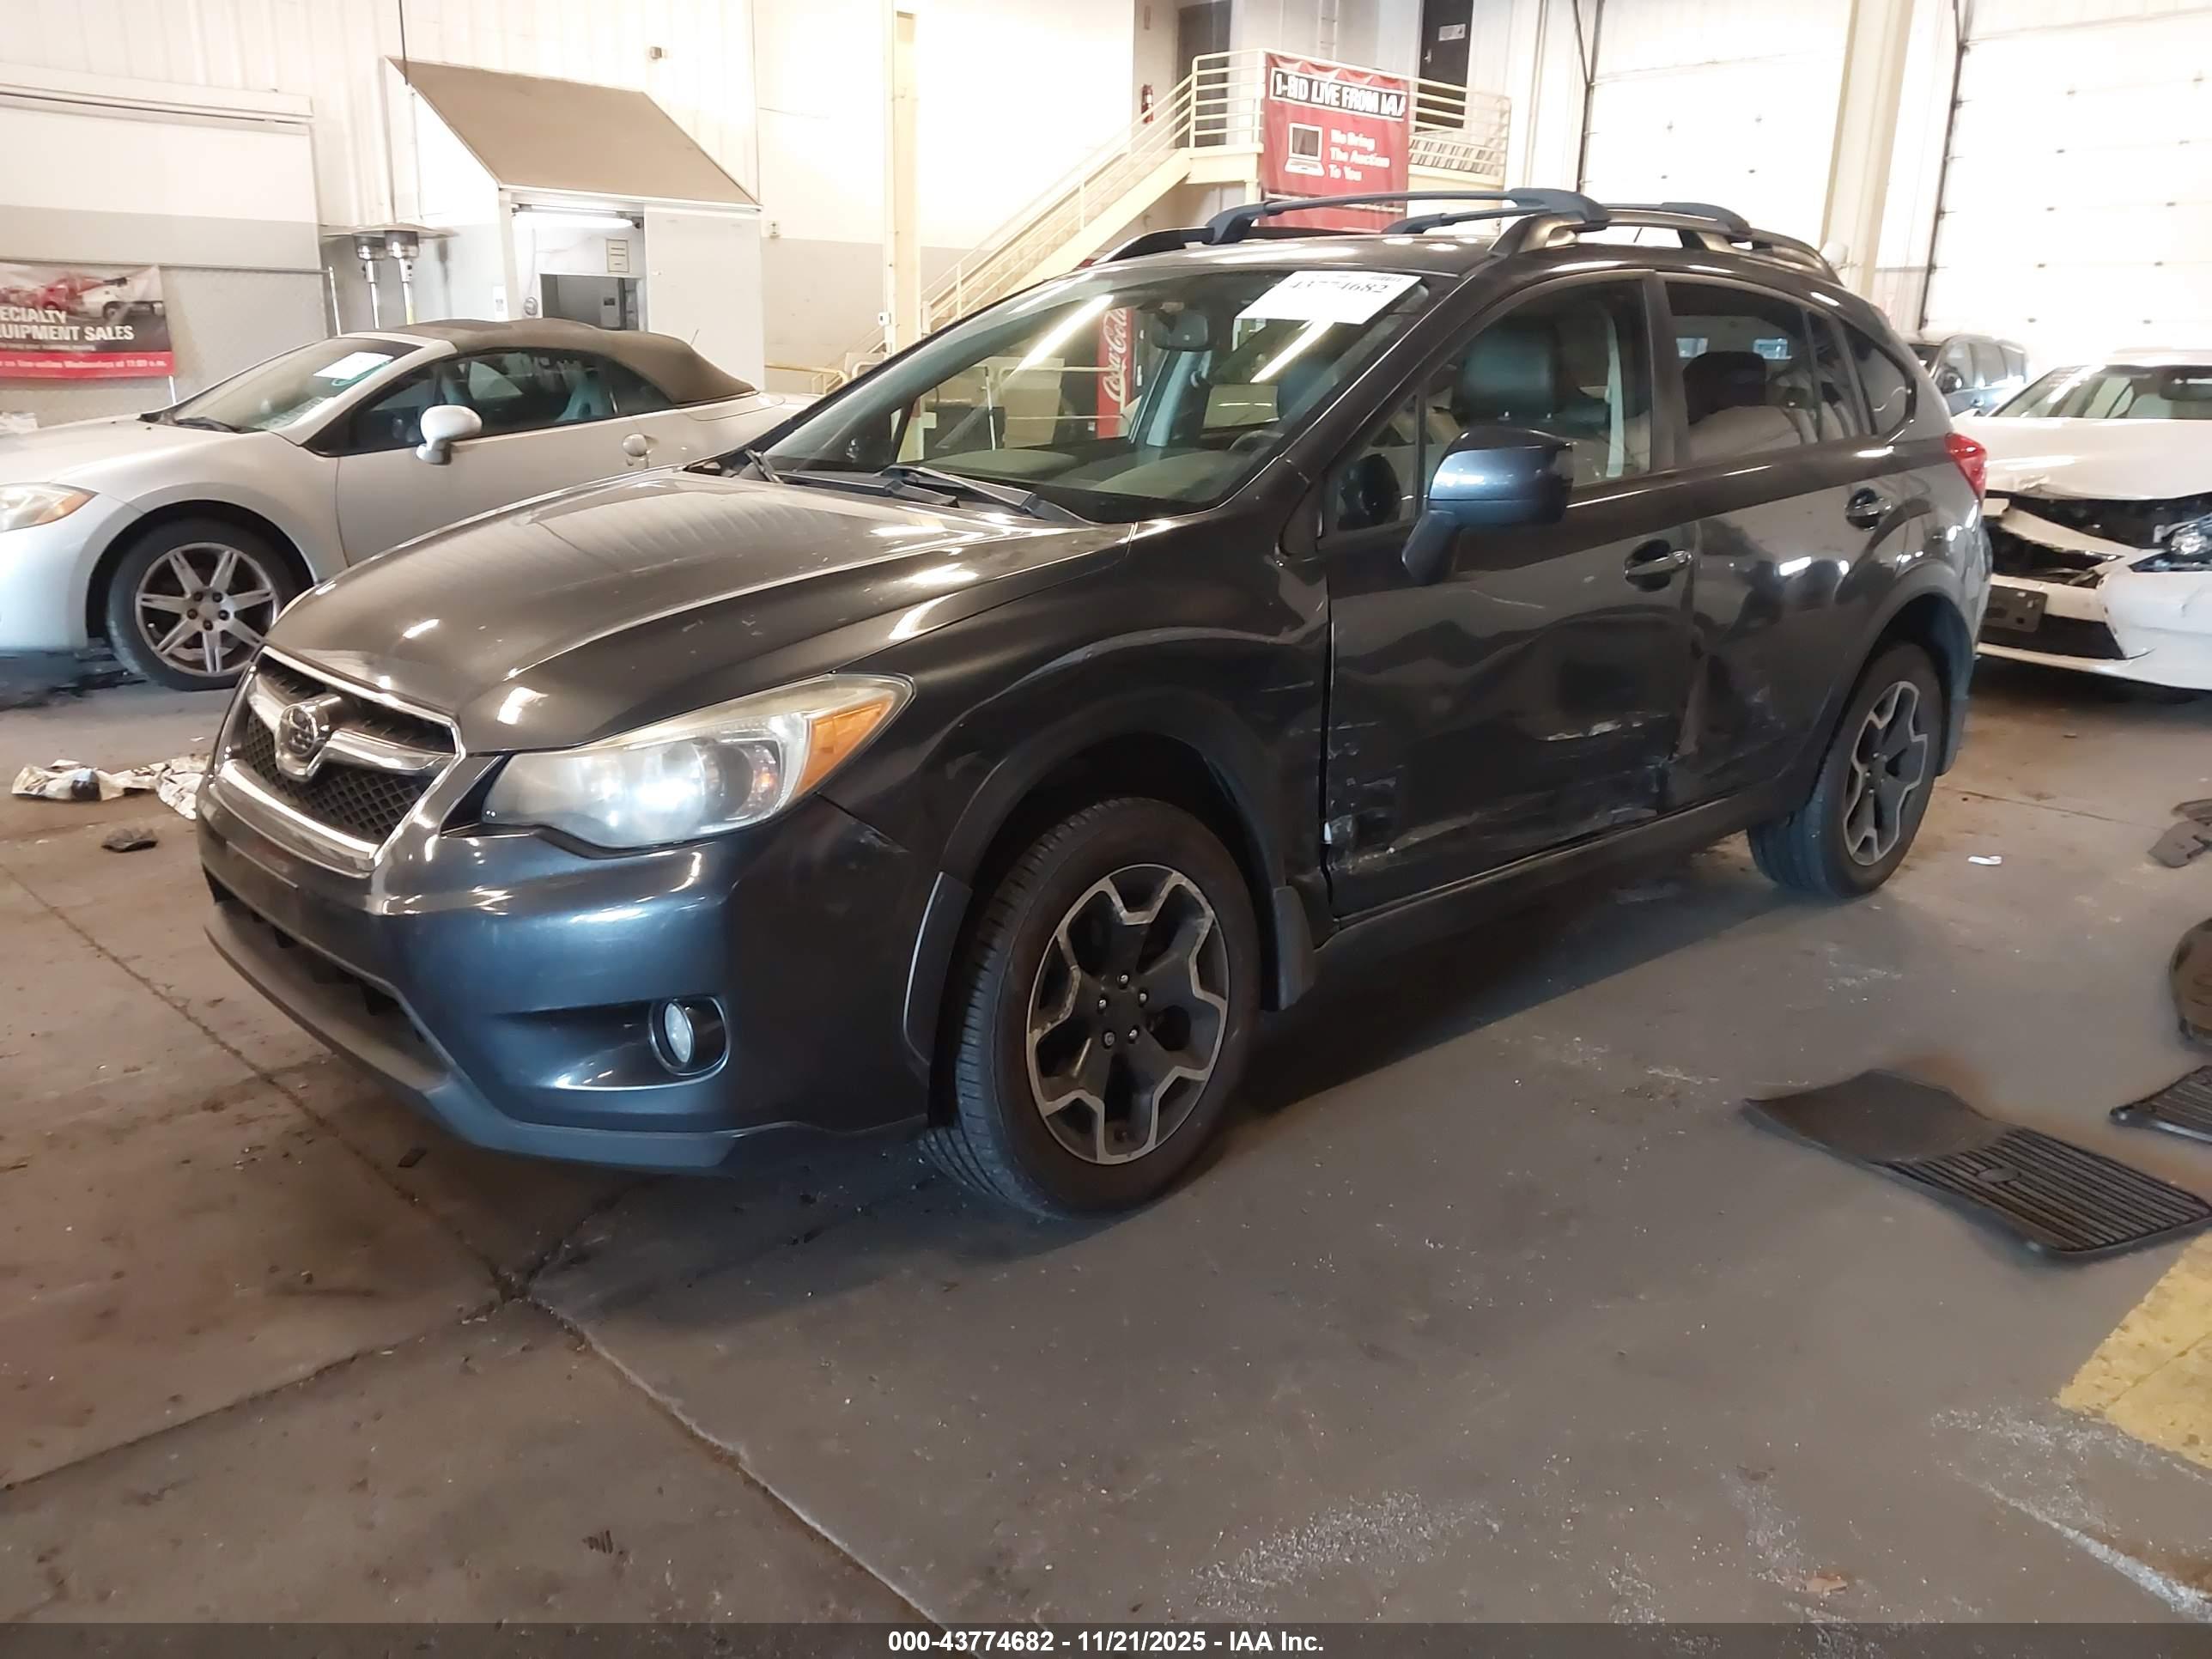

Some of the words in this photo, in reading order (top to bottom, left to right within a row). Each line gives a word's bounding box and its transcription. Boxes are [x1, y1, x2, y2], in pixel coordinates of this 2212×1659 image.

[1310, 80, 1341, 106] LIVE
[1341, 86, 1379, 113] FROM
[1329, 146, 1349, 162] The
[1350, 149, 1391, 168] Auction
[1328, 163, 1342, 179] To
[1343, 165, 1363, 181] You
[84, 325, 135, 341] SALES
